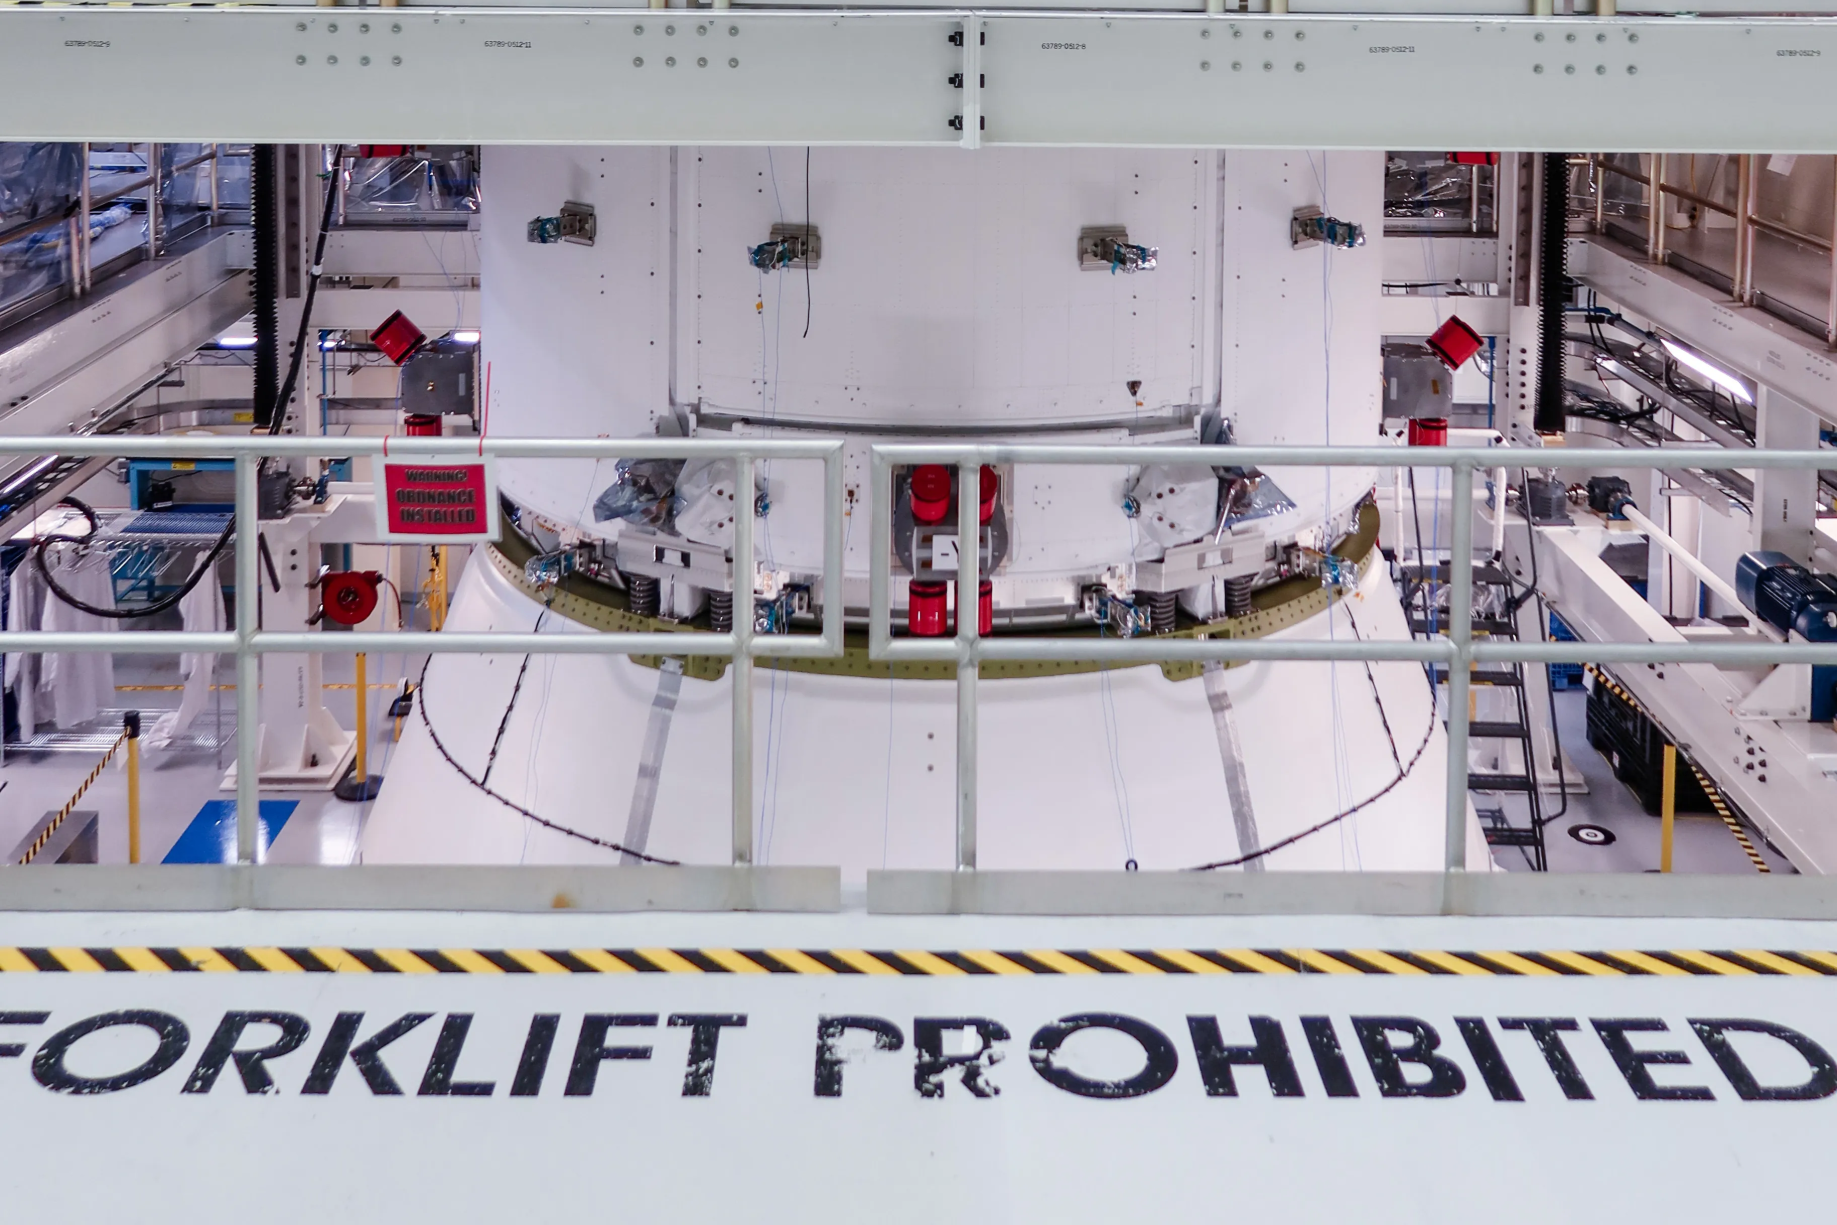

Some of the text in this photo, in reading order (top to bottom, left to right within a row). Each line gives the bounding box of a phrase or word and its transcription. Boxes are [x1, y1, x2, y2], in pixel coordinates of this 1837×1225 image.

[405, 468, 468, 483] WARNING!
[395, 487, 475, 504] ORDNANCE
[400, 507, 476, 523] INSTALLED
[813, 1011, 1837, 1101] PROHIBITED
